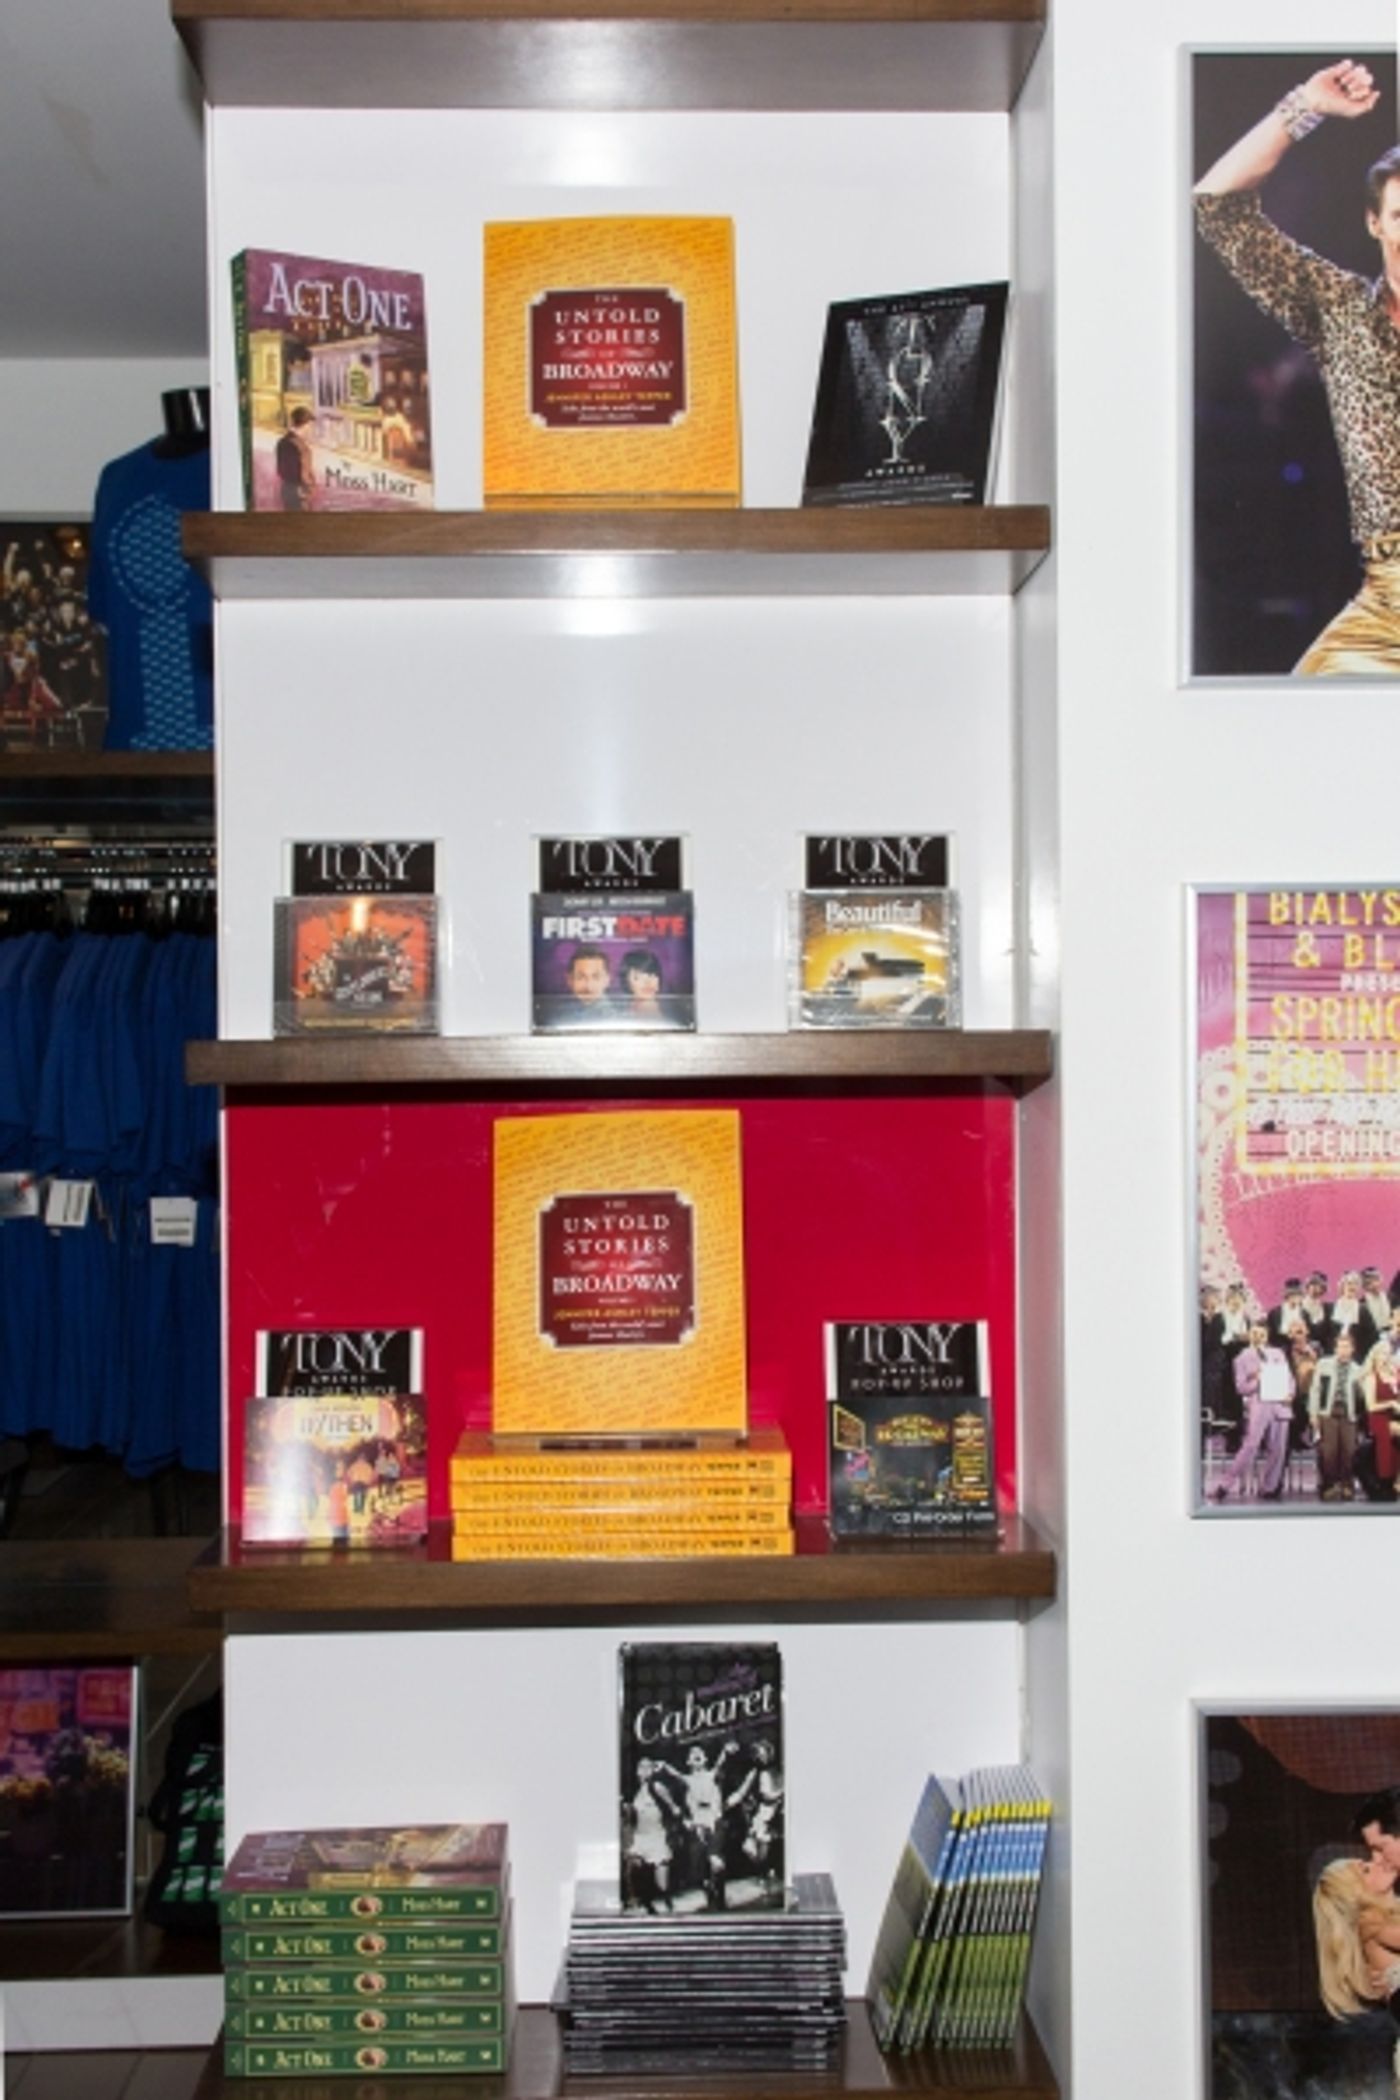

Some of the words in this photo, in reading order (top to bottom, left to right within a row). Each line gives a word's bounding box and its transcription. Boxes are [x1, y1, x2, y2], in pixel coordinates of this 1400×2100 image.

[554, 307, 660, 325] UNTOLD
[554, 328, 660, 344] STORIES
[542, 360, 673, 380] BROADWAY
[307, 842, 420, 880] TONY
[552, 839, 664, 877] TONY
[818, 836, 931, 876] TONY
[1292, 930, 1320, 968] &
[1343, 931, 1400, 971] BL
[563, 1214, 670, 1233] UNTOLD
[563, 1236, 670, 1255] STORIES
[552, 1273, 682, 1294] BROADWAY
[281, 1330, 397, 1373] TONY
[848, 1323, 964, 1365] TONY
[634, 1683, 775, 1744] Cabaret
